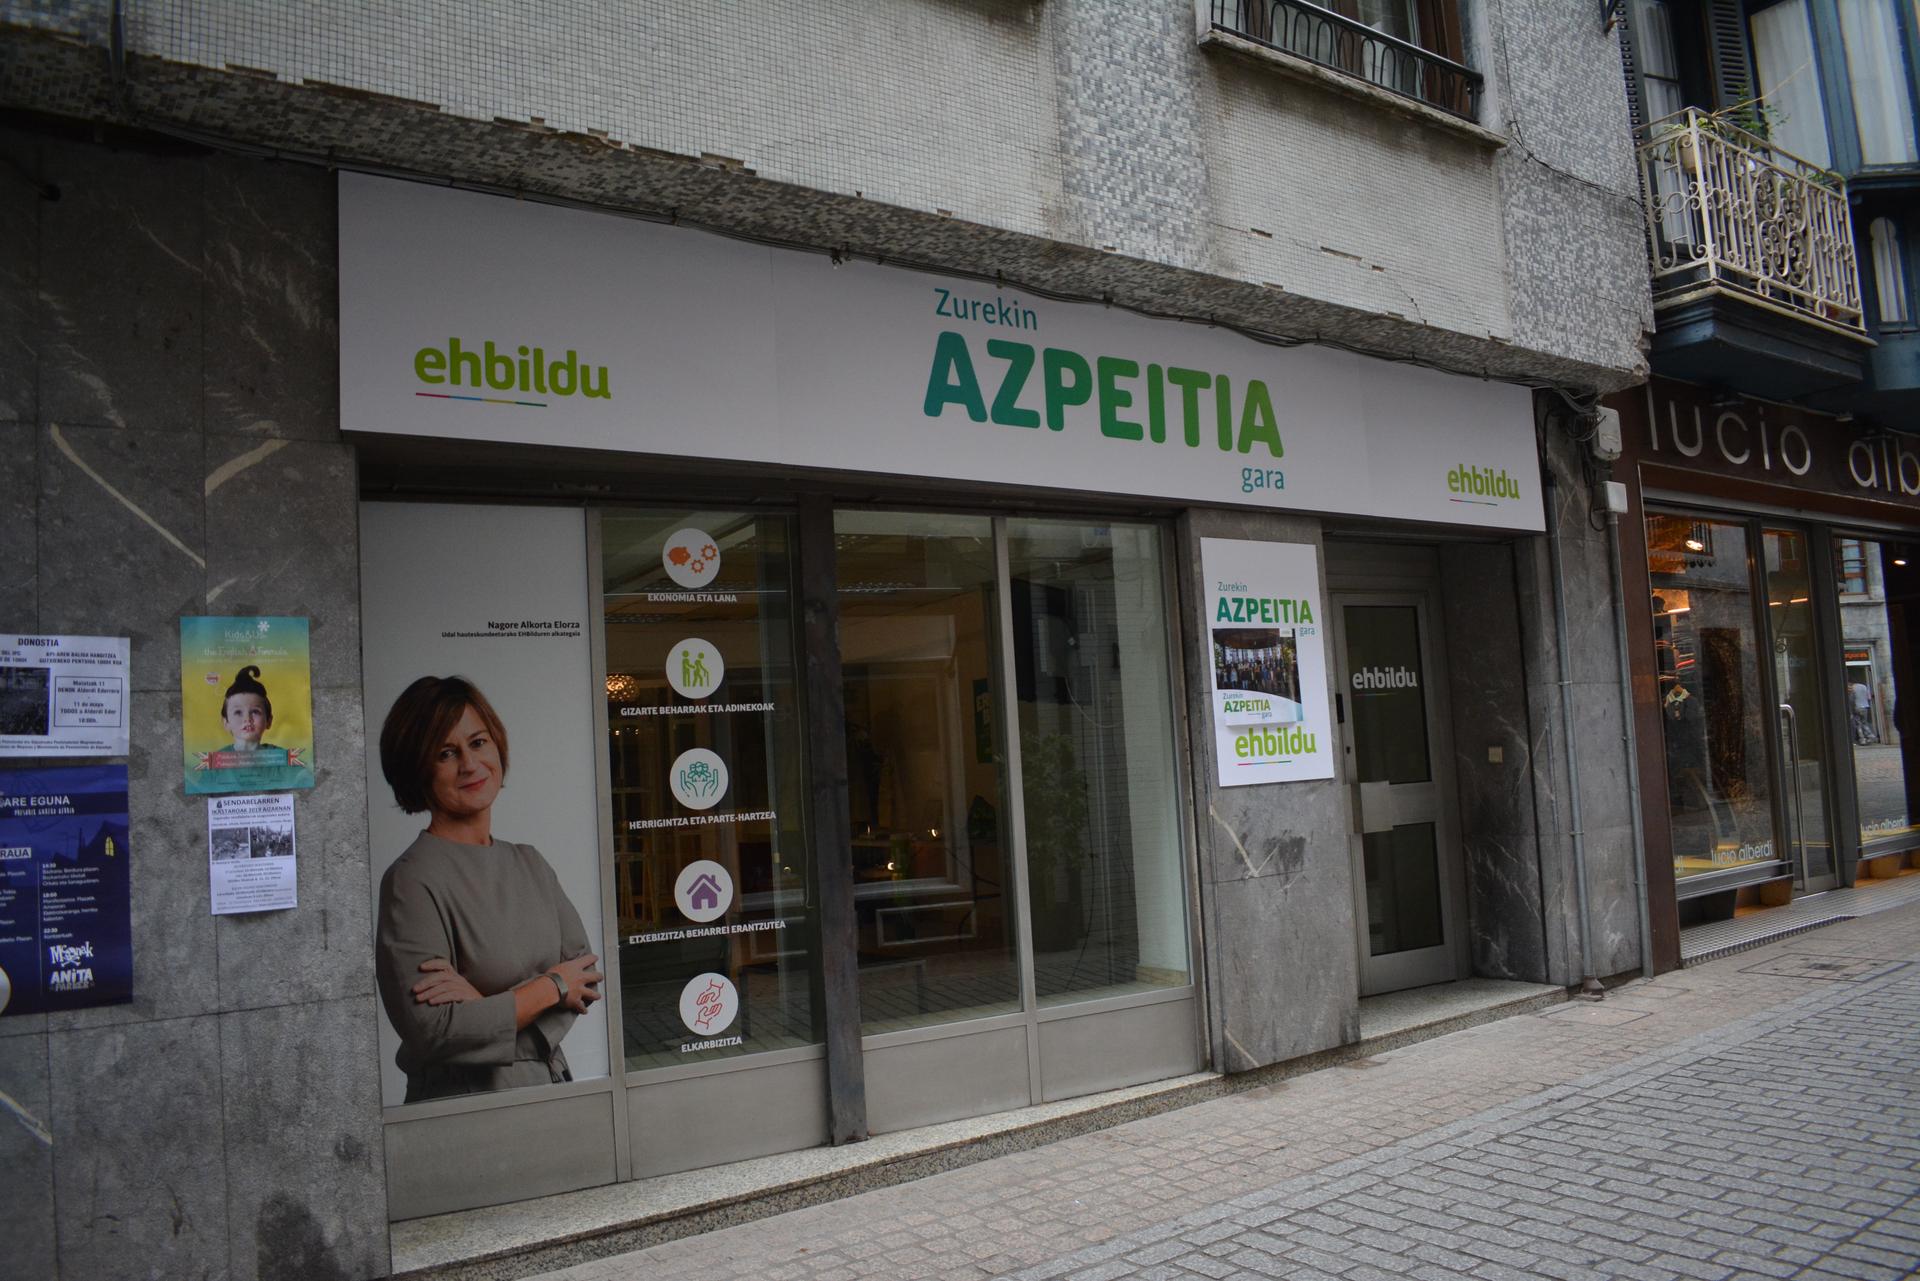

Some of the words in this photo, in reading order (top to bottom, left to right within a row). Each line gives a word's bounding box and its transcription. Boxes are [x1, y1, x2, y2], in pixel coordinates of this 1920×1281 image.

[934, 287, 1038, 331] Zurekin
[414, 337, 611, 399] ehbildu
[924, 330, 1285, 459] AZPEITIA
[1646, 382, 1811, 476] lucio
[1240, 466, 1285, 493] gara
[1447, 463, 1521, 500] ehbildu
[647, 592, 696, 602] EKONOMIA
[697, 593, 713, 602] ETA
[714, 593, 737, 603] LANA
[1217, 581, 1248, 592] Zurekin
[1216, 596, 1314, 624] AZPEITIA
[487, 620, 520, 631] Nagore
[520, 619, 552, 629] Alkorta
[554, 619, 581, 629] Elorza
[1299, 627, 1316, 637] gara
[17, 638, 60, 647] DONOSTIA
[1352, 665, 1419, 690] ehbildu
[620, 706, 658, 717] GIZARTE
[659, 704, 707, 715] BEHARRAK
[708, 703, 726, 713] ETA
[726, 702, 776, 713] ADINEKOAK
[1223, 699, 1271, 713] AZPEITIA
[1234, 726, 1317, 758] ehbildu
[30, 795, 71, 807] EGUNA
[629, 817, 689, 830] HERRIGINTZA
[690, 815, 707, 826] ETA
[707, 811, 778, 824] PARTE-HARTZEA
[1711, 848, 1736, 865] lucio
[1738, 839, 1773, 861] alberdi
[629, 931, 685, 944] ETXEBIZITZA
[686, 925, 730, 938] BEHARREI
[731, 920, 787, 934] ERANTZUTEA
[681, 1036, 743, 1053] ELKARBIZITZA
